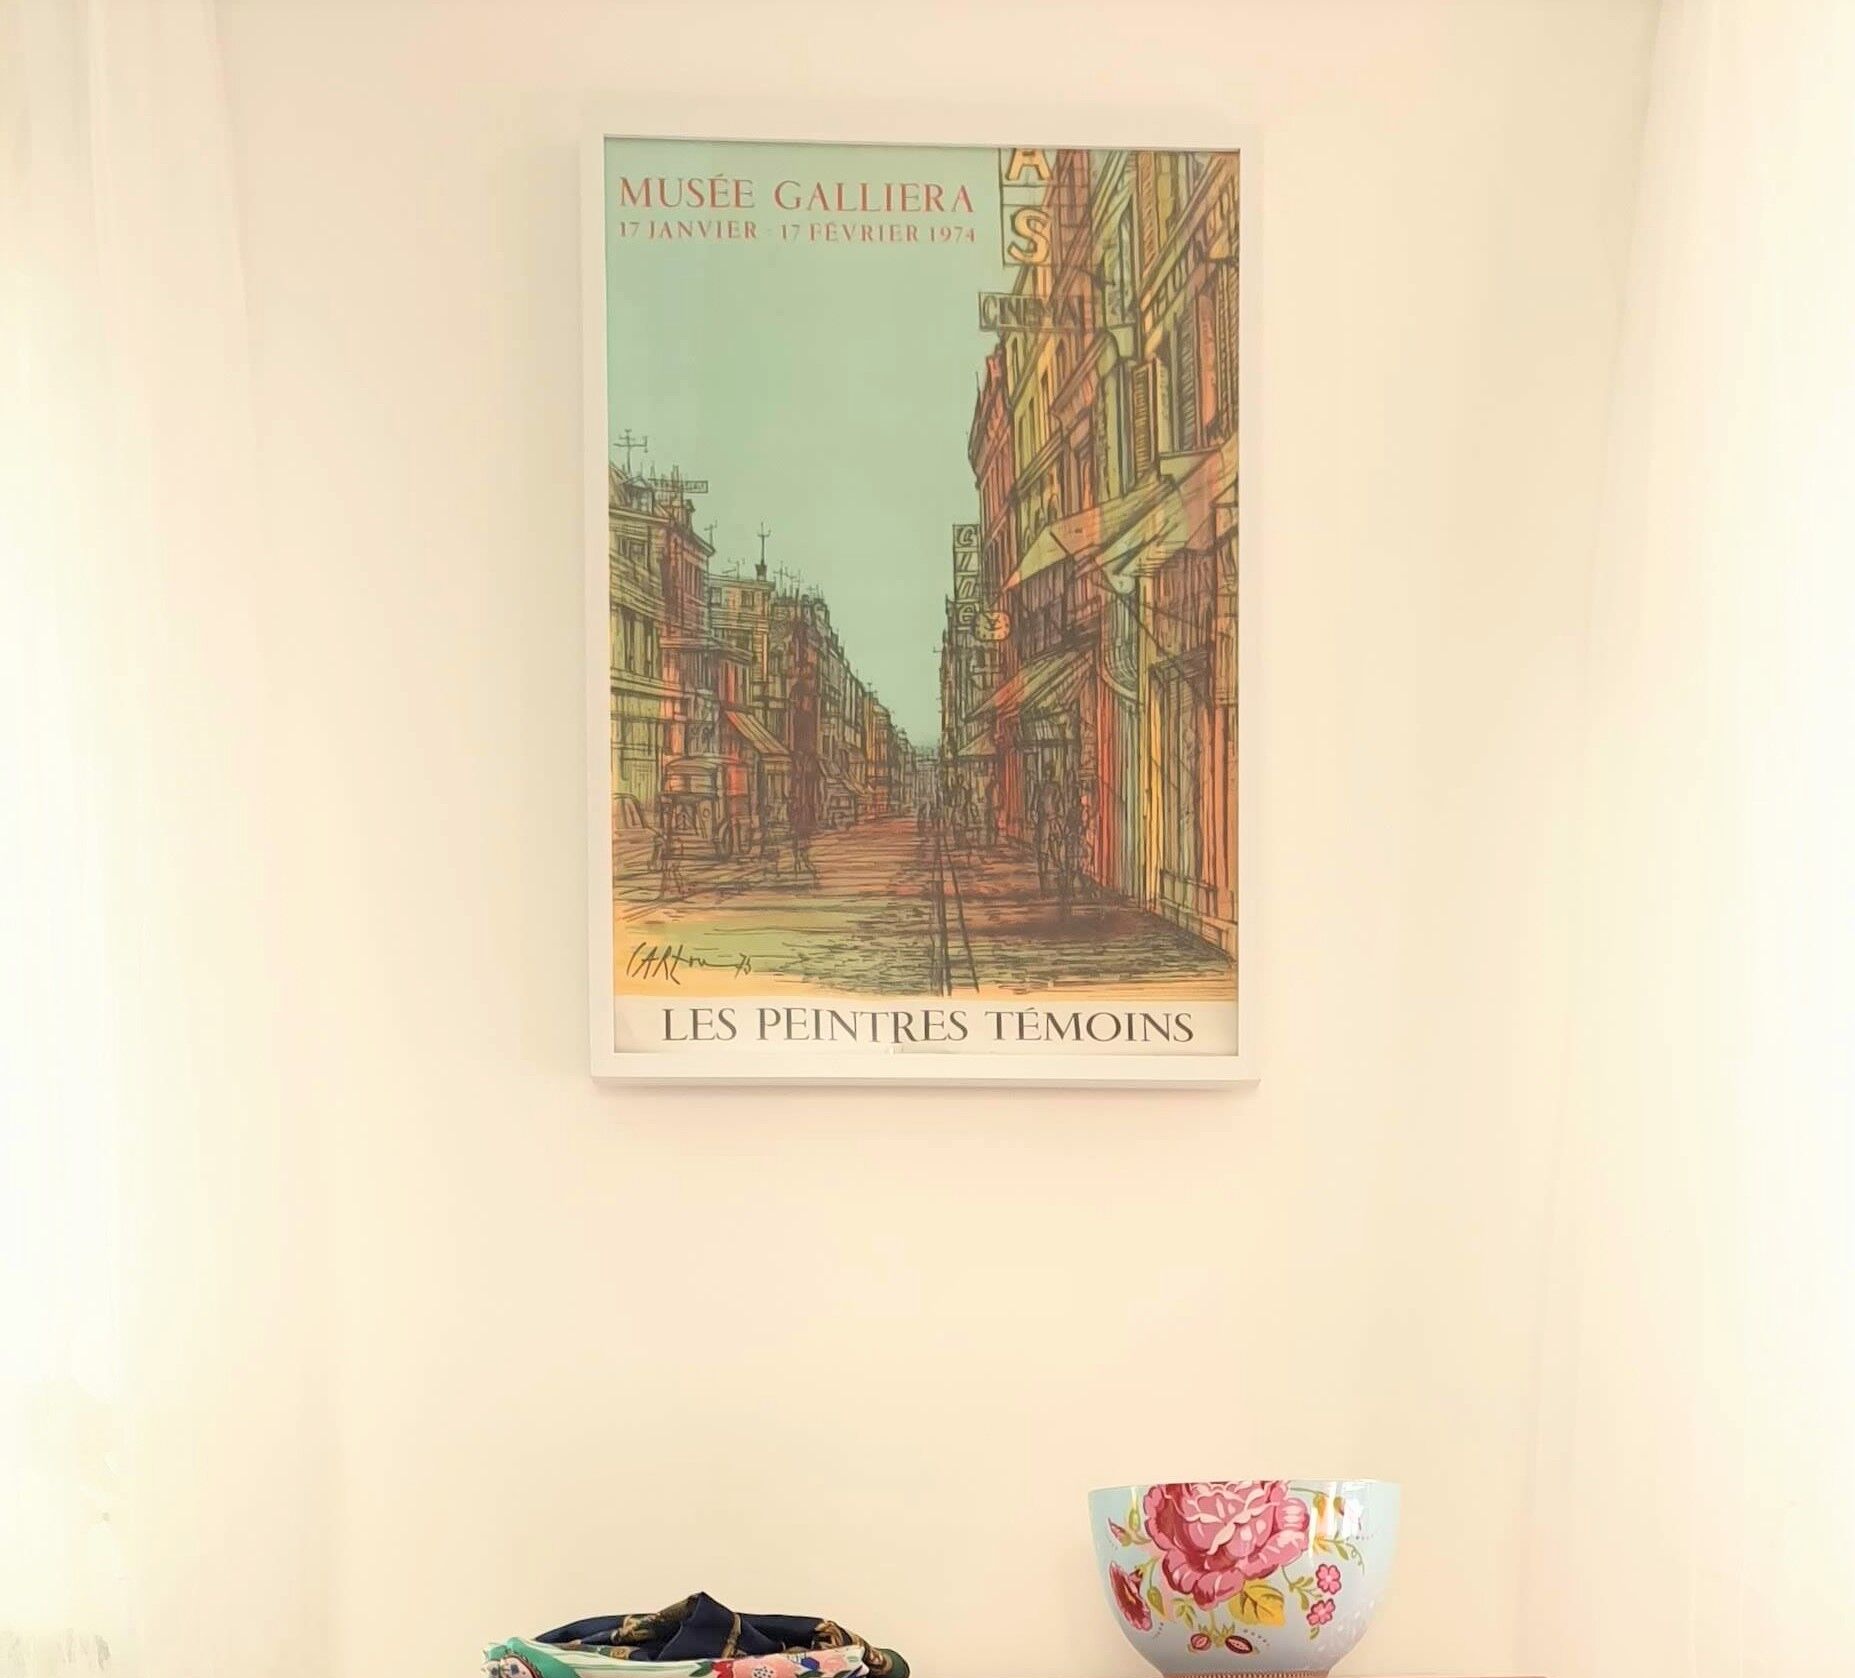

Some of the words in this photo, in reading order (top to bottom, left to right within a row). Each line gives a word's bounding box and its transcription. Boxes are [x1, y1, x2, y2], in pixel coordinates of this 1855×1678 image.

[619, 173, 755, 209] MUSÉE
[774, 179, 974, 214] GALLIERA
[619, 221, 640, 237] 17
[649, 220, 757, 239] JANVIER
[782, 224, 800, 241] 17
[809, 220, 919, 243] FÉVRIER
[930, 226, 976, 243] 1974
[662, 1007, 737, 1041] LES
[756, 1006, 969, 1044] PEINTRES
[984, 1007, 1194, 1043] TÉMOINS
